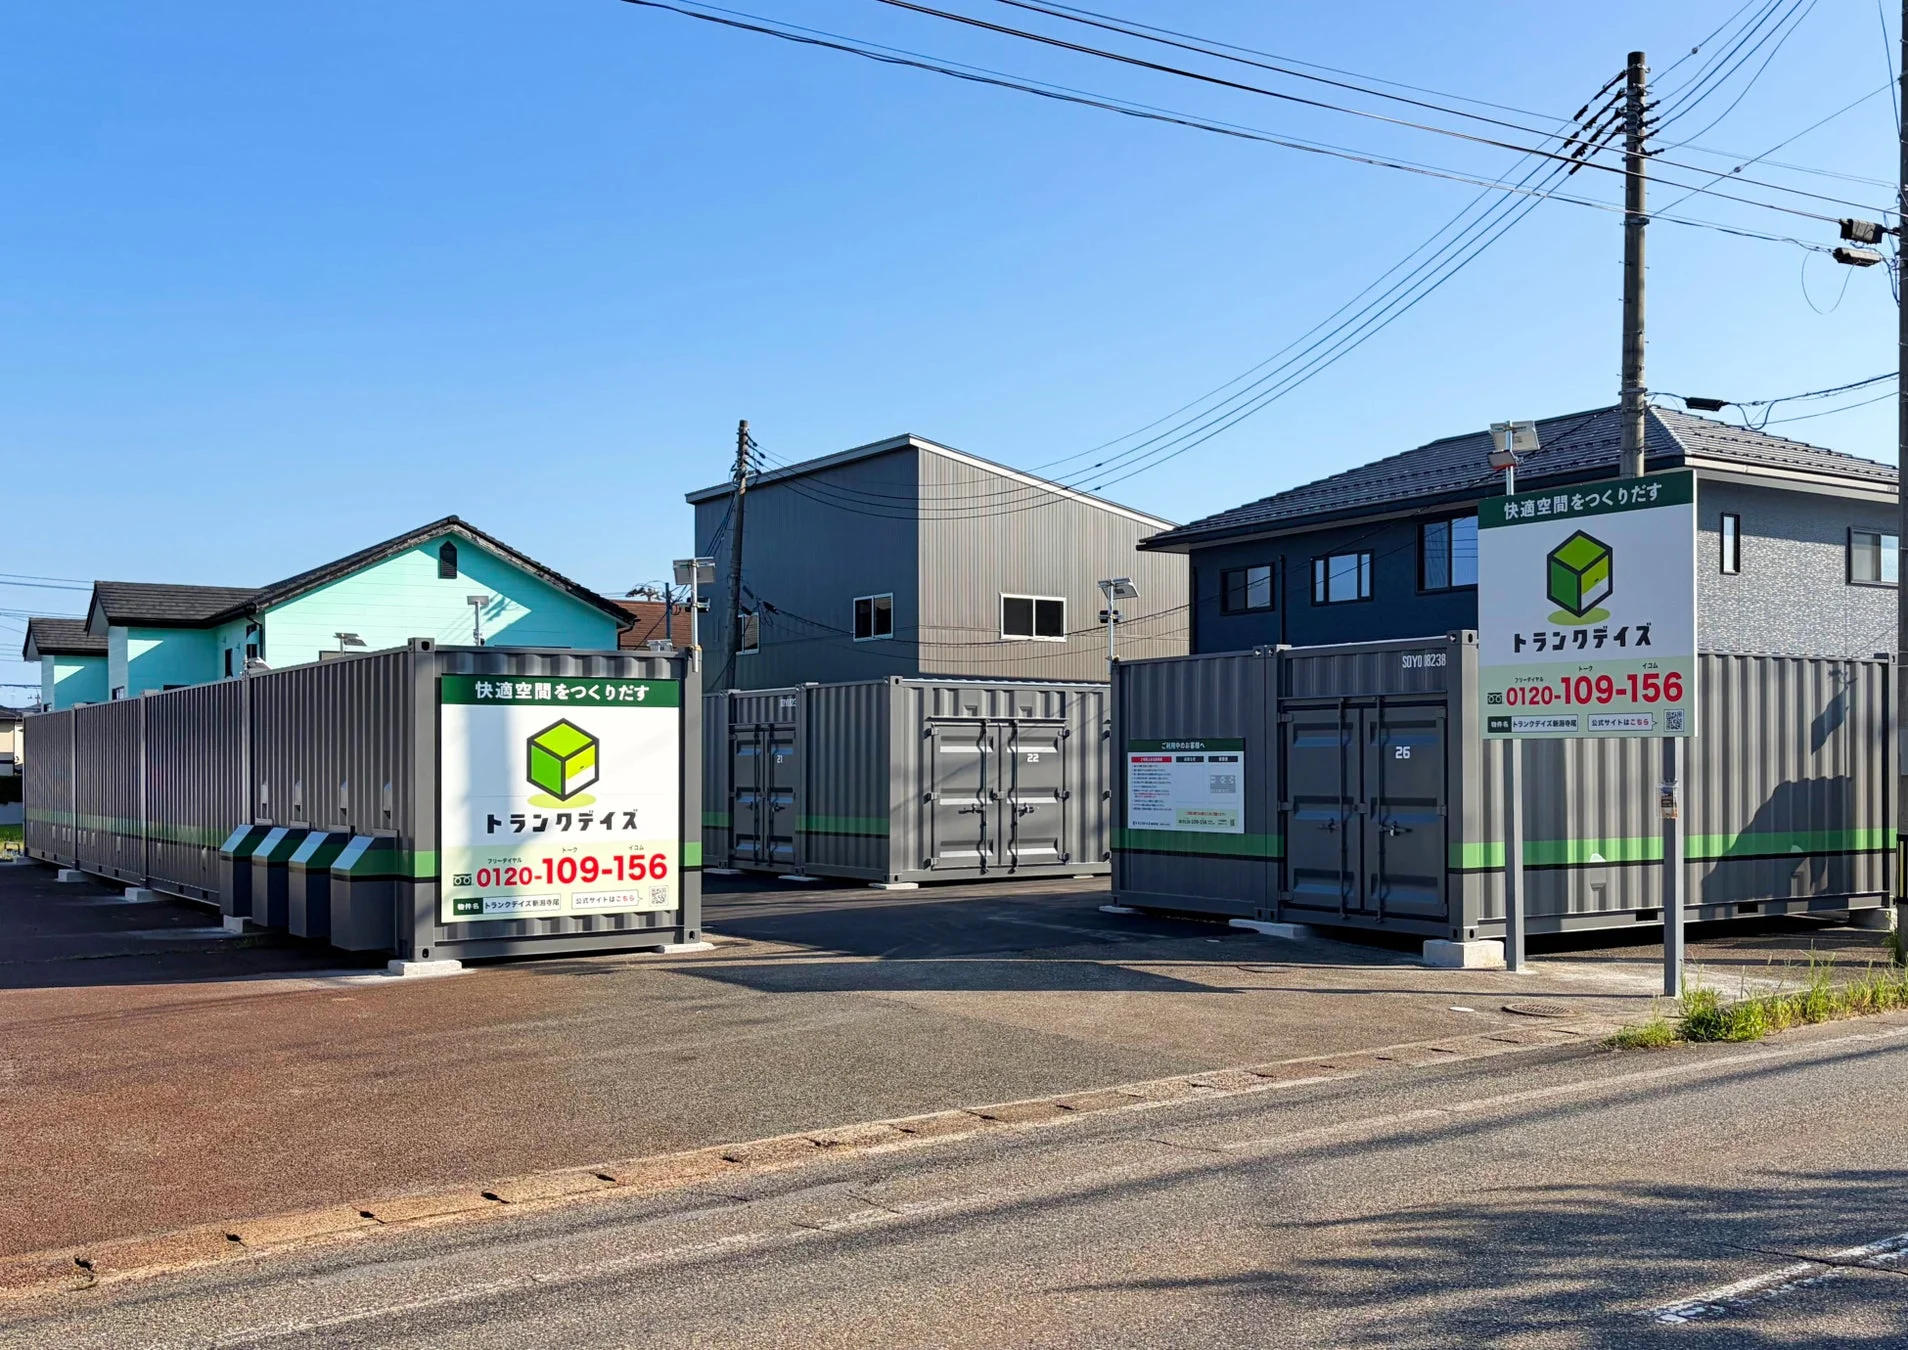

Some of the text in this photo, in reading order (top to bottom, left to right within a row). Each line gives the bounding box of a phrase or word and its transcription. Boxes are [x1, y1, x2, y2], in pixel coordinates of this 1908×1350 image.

[1504, 483, 1662, 520] 快適空間をつくりだす
[1514, 622, 1652, 653] トランクデイズ
[475, 681, 649, 701] 快適空間をつくりだす
[1506, 671, 1683, 706] 0120-109-156
[1591, 717, 1649, 727] 公式サイトはこちら
[1026, 753, 1039, 763] 22
[1395, 745, 1411, 759] 26
[487, 809, 638, 834] トランクデイズ
[562, 846, 578, 854] トーク
[628, 844, 645, 852] イコム
[487, 857, 523, 865] フリーダイヤル
[476, 853, 668, 888] 0120-109-156
[575, 894, 636, 905] 公式サイトはこちら
